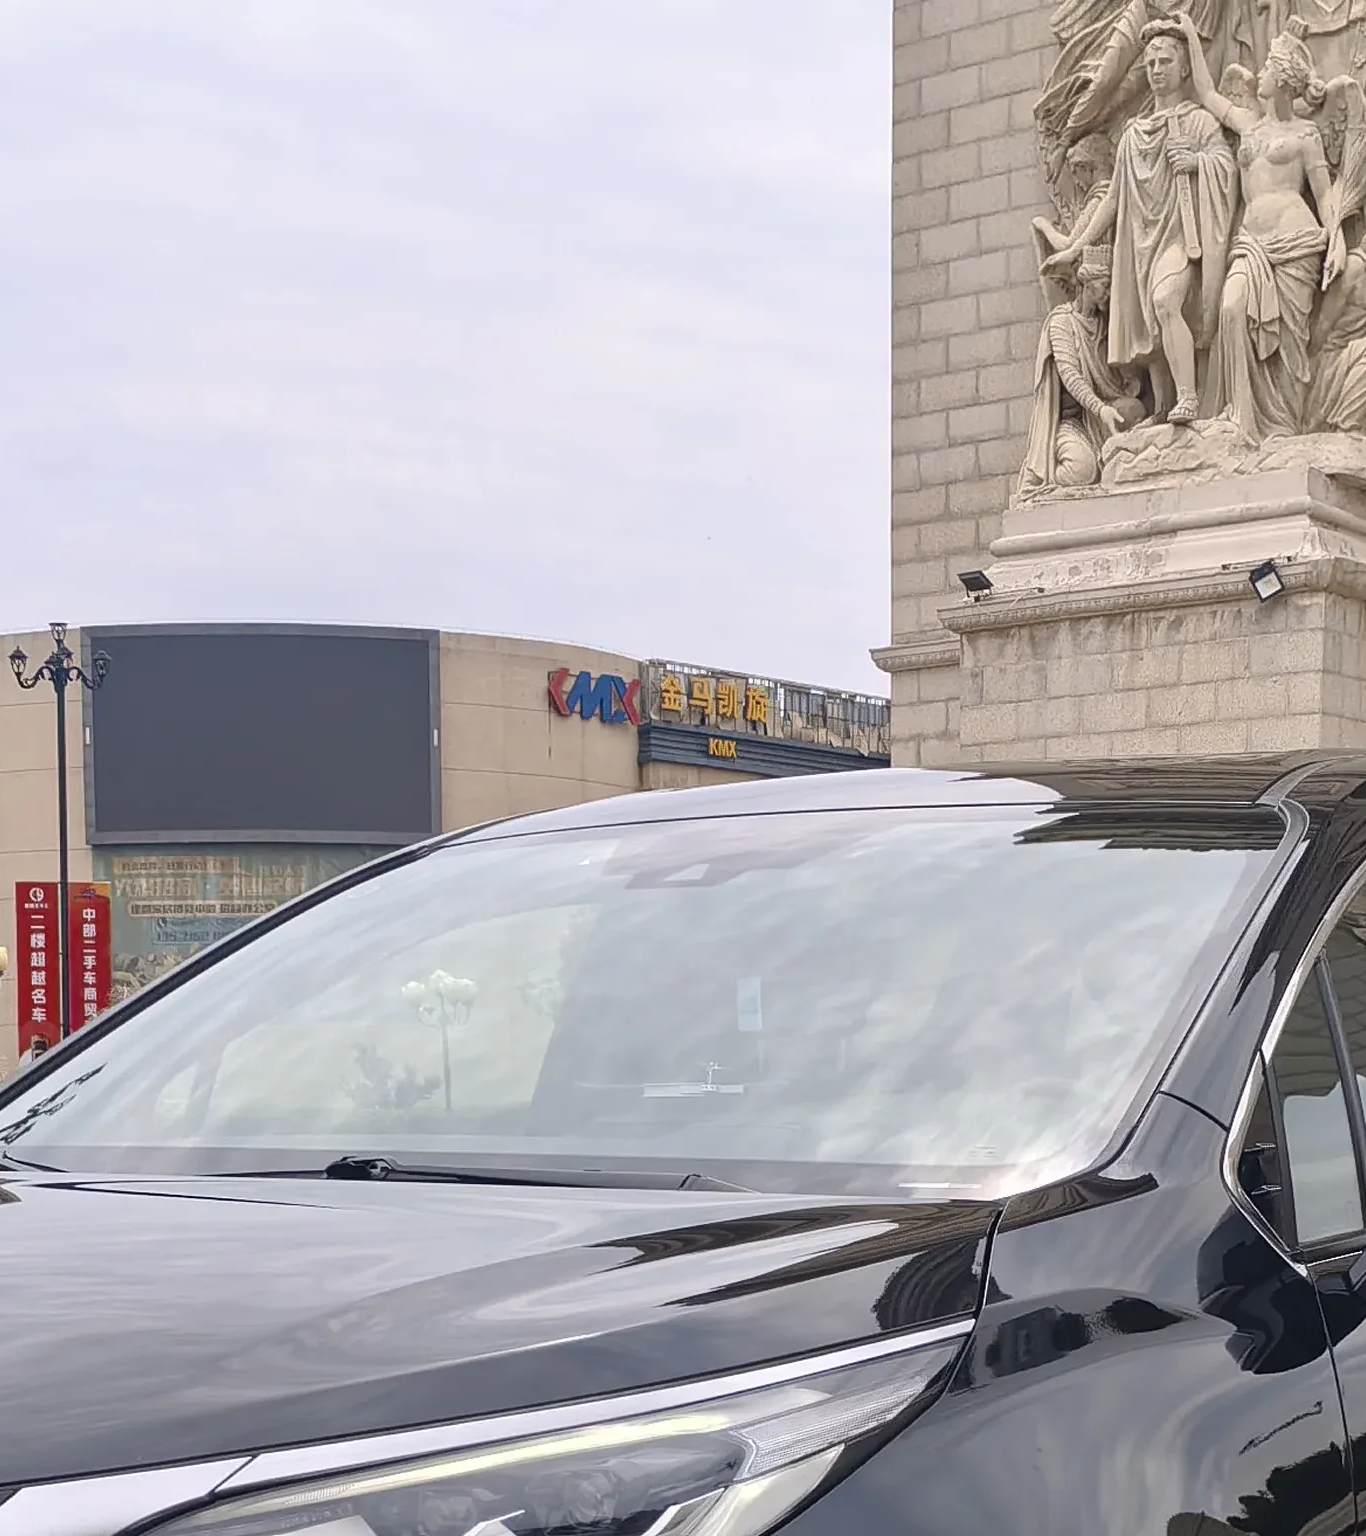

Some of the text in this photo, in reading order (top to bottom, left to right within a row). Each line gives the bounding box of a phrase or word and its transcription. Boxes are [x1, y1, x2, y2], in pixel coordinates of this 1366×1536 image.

[660, 674, 770, 724] 金马凯旋
[709, 737, 737, 758] KMX
[30, 914, 47, 1023] 二楼超越名车
